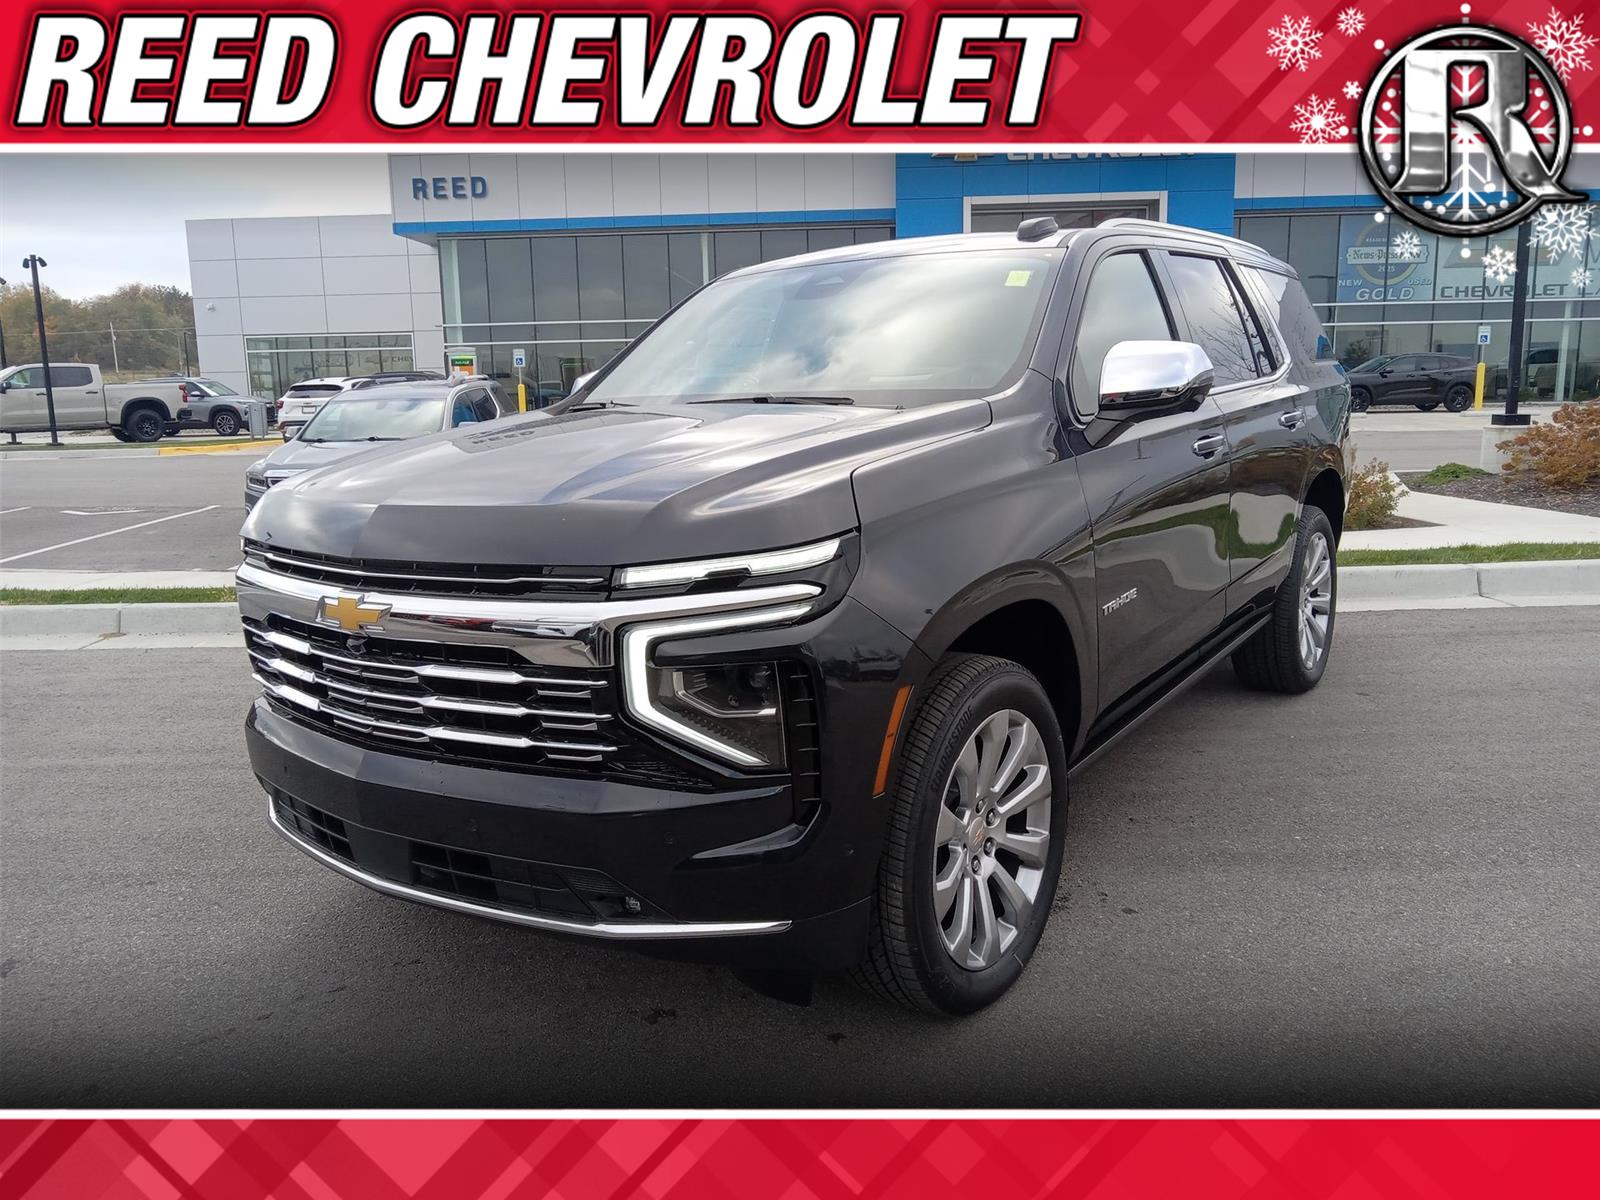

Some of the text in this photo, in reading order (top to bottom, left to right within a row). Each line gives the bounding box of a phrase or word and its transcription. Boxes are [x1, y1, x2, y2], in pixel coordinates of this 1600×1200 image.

[412, 176, 488, 200] REED
[1338, 279, 1363, 287] NEW
[1440, 283, 1569, 299] CHEVRLET
[1355, 287, 1415, 301] GOLD
[1101, 587, 1138, 616] TAHOE
